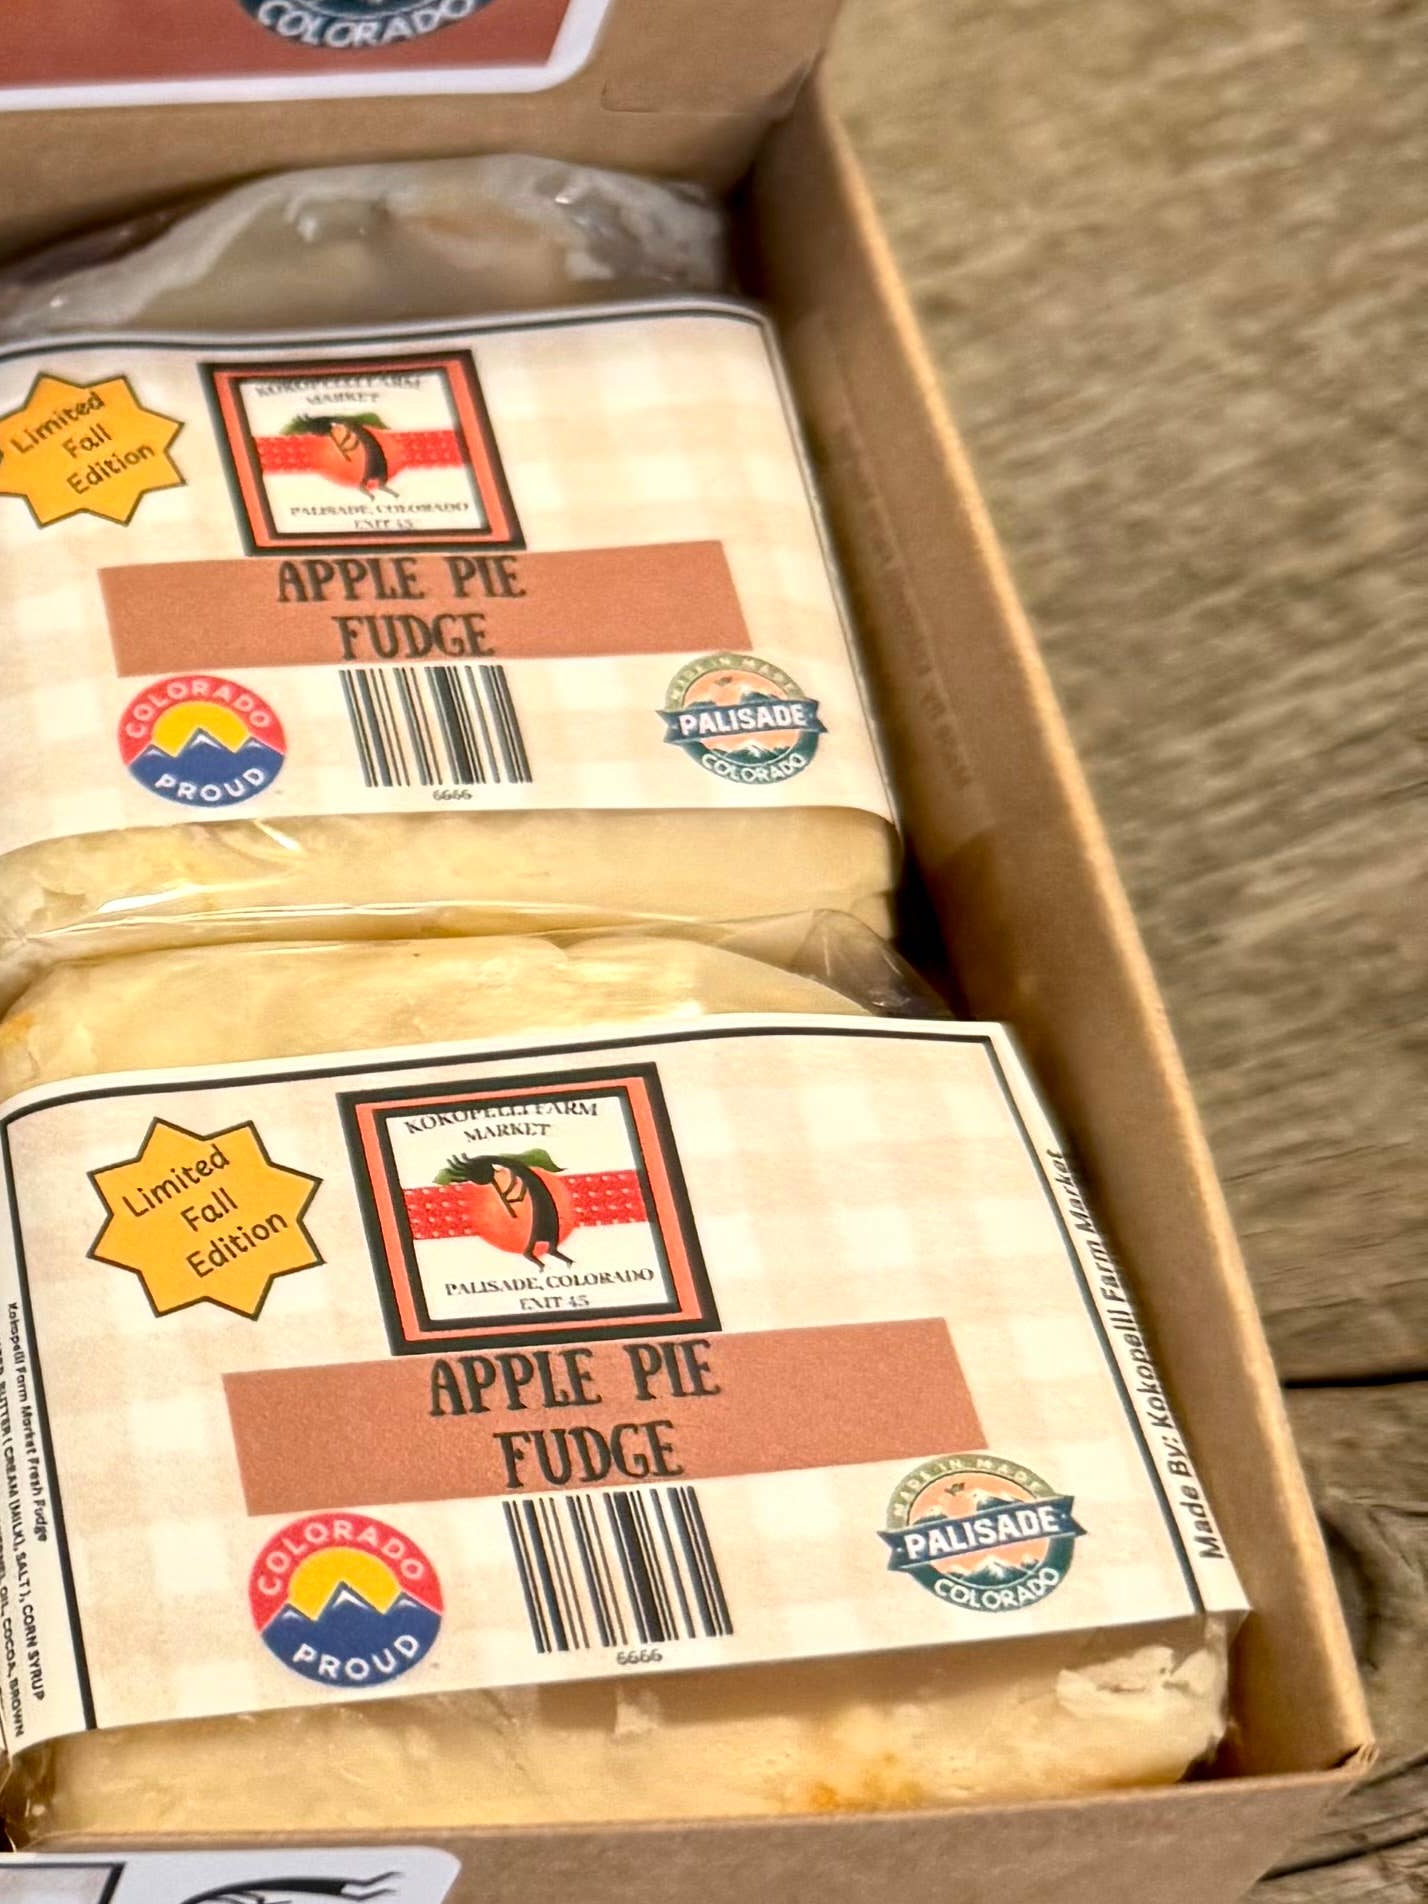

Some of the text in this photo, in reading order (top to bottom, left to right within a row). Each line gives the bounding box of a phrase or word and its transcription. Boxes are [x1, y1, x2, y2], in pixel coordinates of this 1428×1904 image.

[9, 392, 106, 456] Limited
[62, 425, 112, 459] Fall
[66, 443, 155, 495] Edition
[276, 555, 527, 603] APPLE PIE
[331, 612, 495, 661] FUDGE
[126, 680, 272, 739] COLORADO
[679, 703, 807, 737] PALISADE
[154, 769, 265, 804] PROUD
[701, 753, 807, 784] COLORADO
[120, 1143, 231, 1218] Limited
[180, 1188, 239, 1233] Fall
[185, 1208, 289, 1279] Edition
[546, 1268, 654, 1291] COLORADO
[1084, 1240, 1127, 1304] Farm
[427, 1338, 721, 1418] APPLE PIE
[491, 1420, 685, 1489] FUDGE
[1164, 1433, 1192, 1480] By:
[907, 1508, 1060, 1556] PALISADE
[1181, 1485, 1225, 1560] Made
[258, 1519, 424, 1598] COLORADO
[931, 1568, 1060, 1609] COLORADO
[291, 1634, 421, 1680] PROUD
